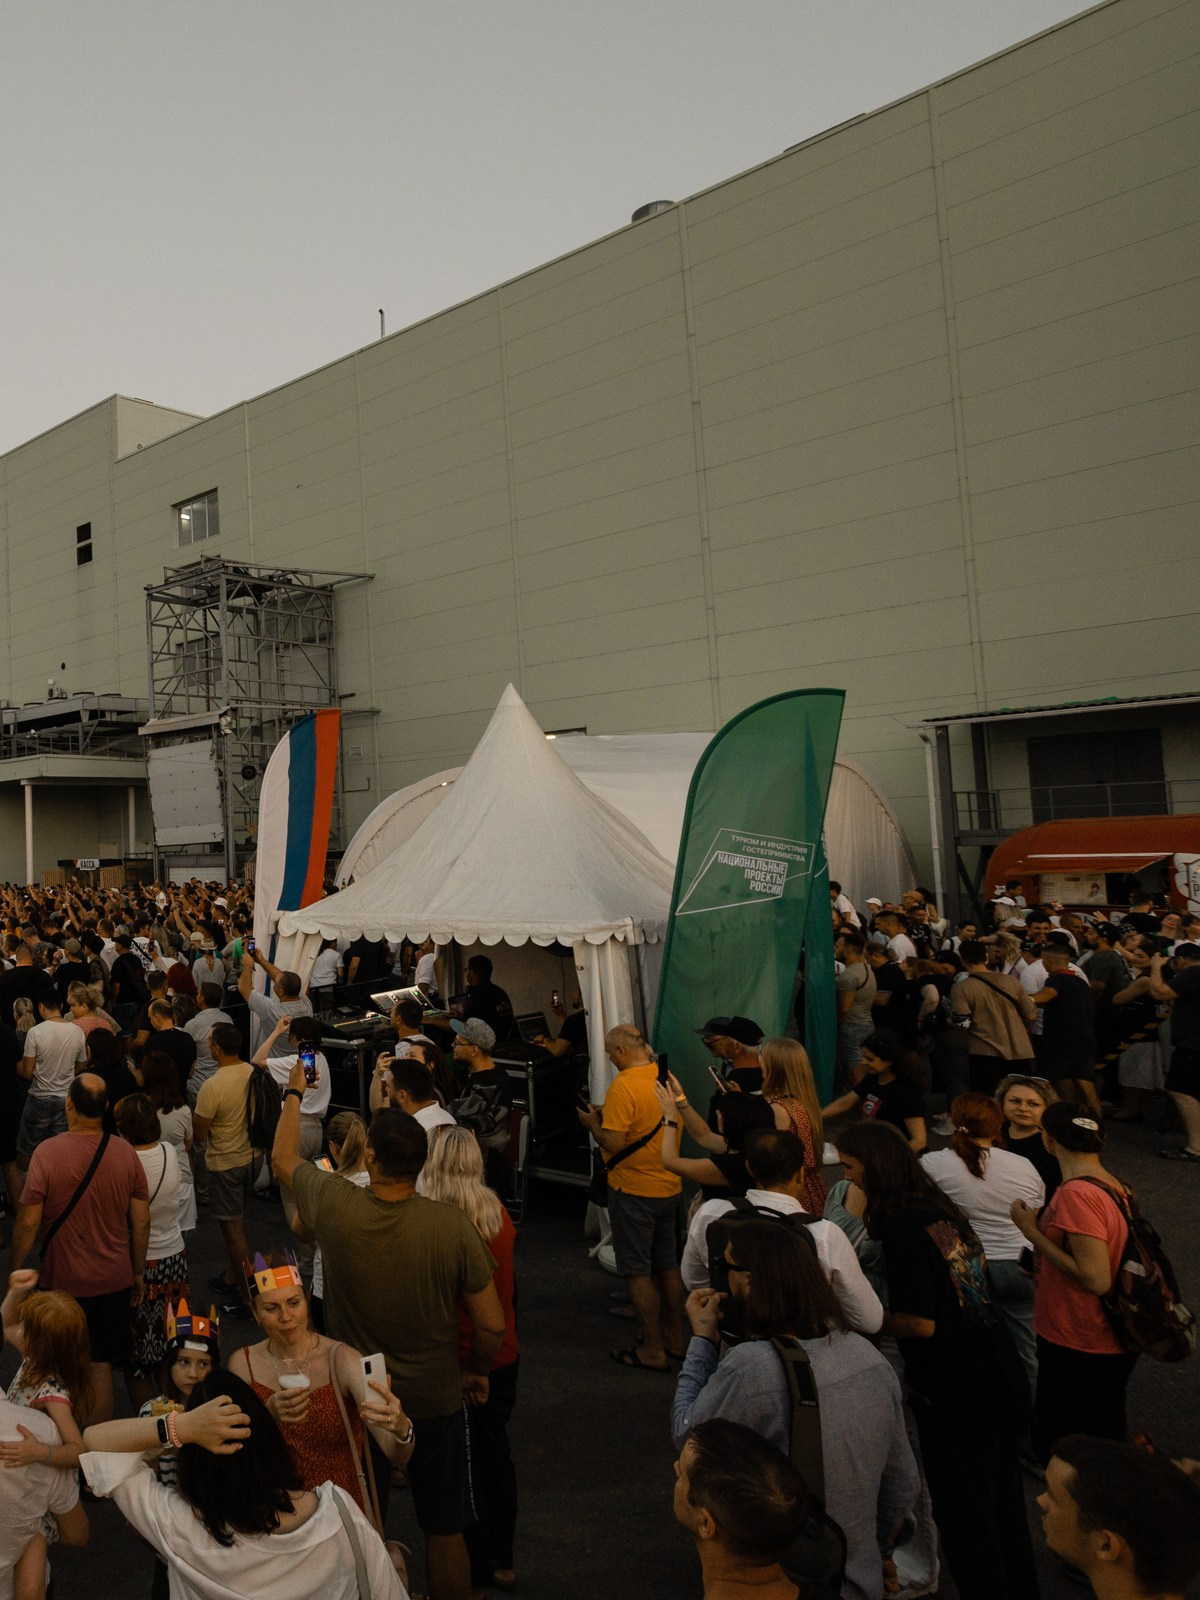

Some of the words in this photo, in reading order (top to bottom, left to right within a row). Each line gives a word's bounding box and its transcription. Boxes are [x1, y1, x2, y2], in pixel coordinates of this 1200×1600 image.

[731, 834, 760, 847] ТУРИЗМ
[767, 840, 808, 855] ИНДУСТРИЯ
[742, 845, 806, 863] ГОСТЕПРИИМСТВА
[717, 853, 786, 875] НАЦИОНАЛЬНЫЕ
[744, 868, 785, 885] ПРОЕКТЫ
[749, 880, 783, 896] РОССИИ
